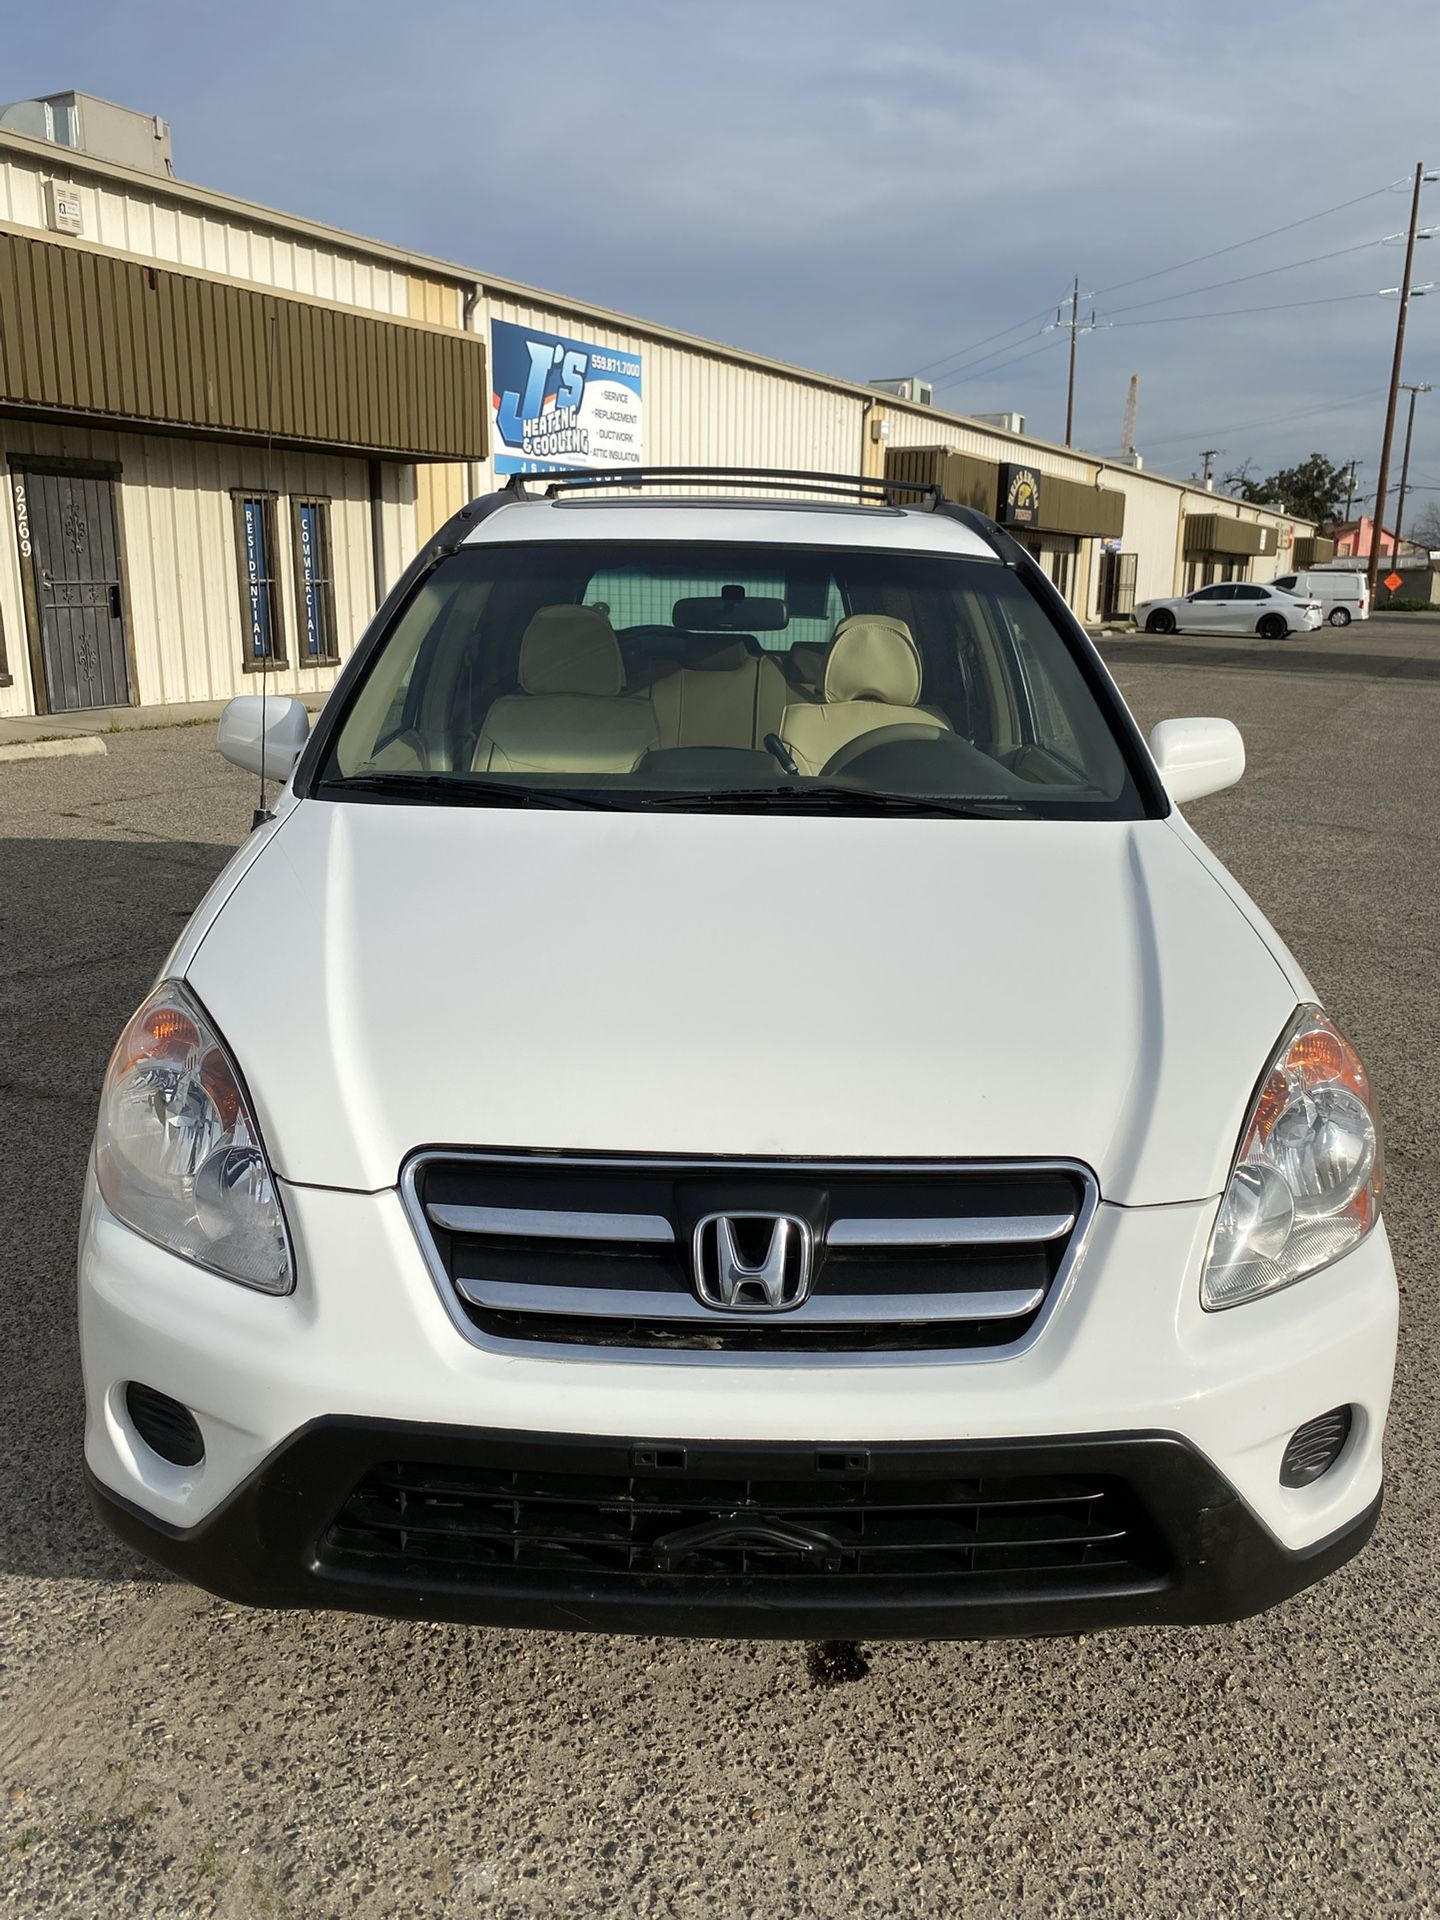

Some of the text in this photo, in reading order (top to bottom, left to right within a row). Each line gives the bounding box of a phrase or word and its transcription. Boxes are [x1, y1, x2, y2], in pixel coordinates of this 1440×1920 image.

[591, 354, 640, 378] 559.871.7000
[522, 404, 578, 437] HEATING
[522, 429, 589, 457] & COOLING
[609, 449, 640, 463] INSULATION
[15, 485, 32, 558] 2269
[245, 510, 261, 646] RESIDENTIAL
[301, 519, 315, 642] COMMERCIAL
